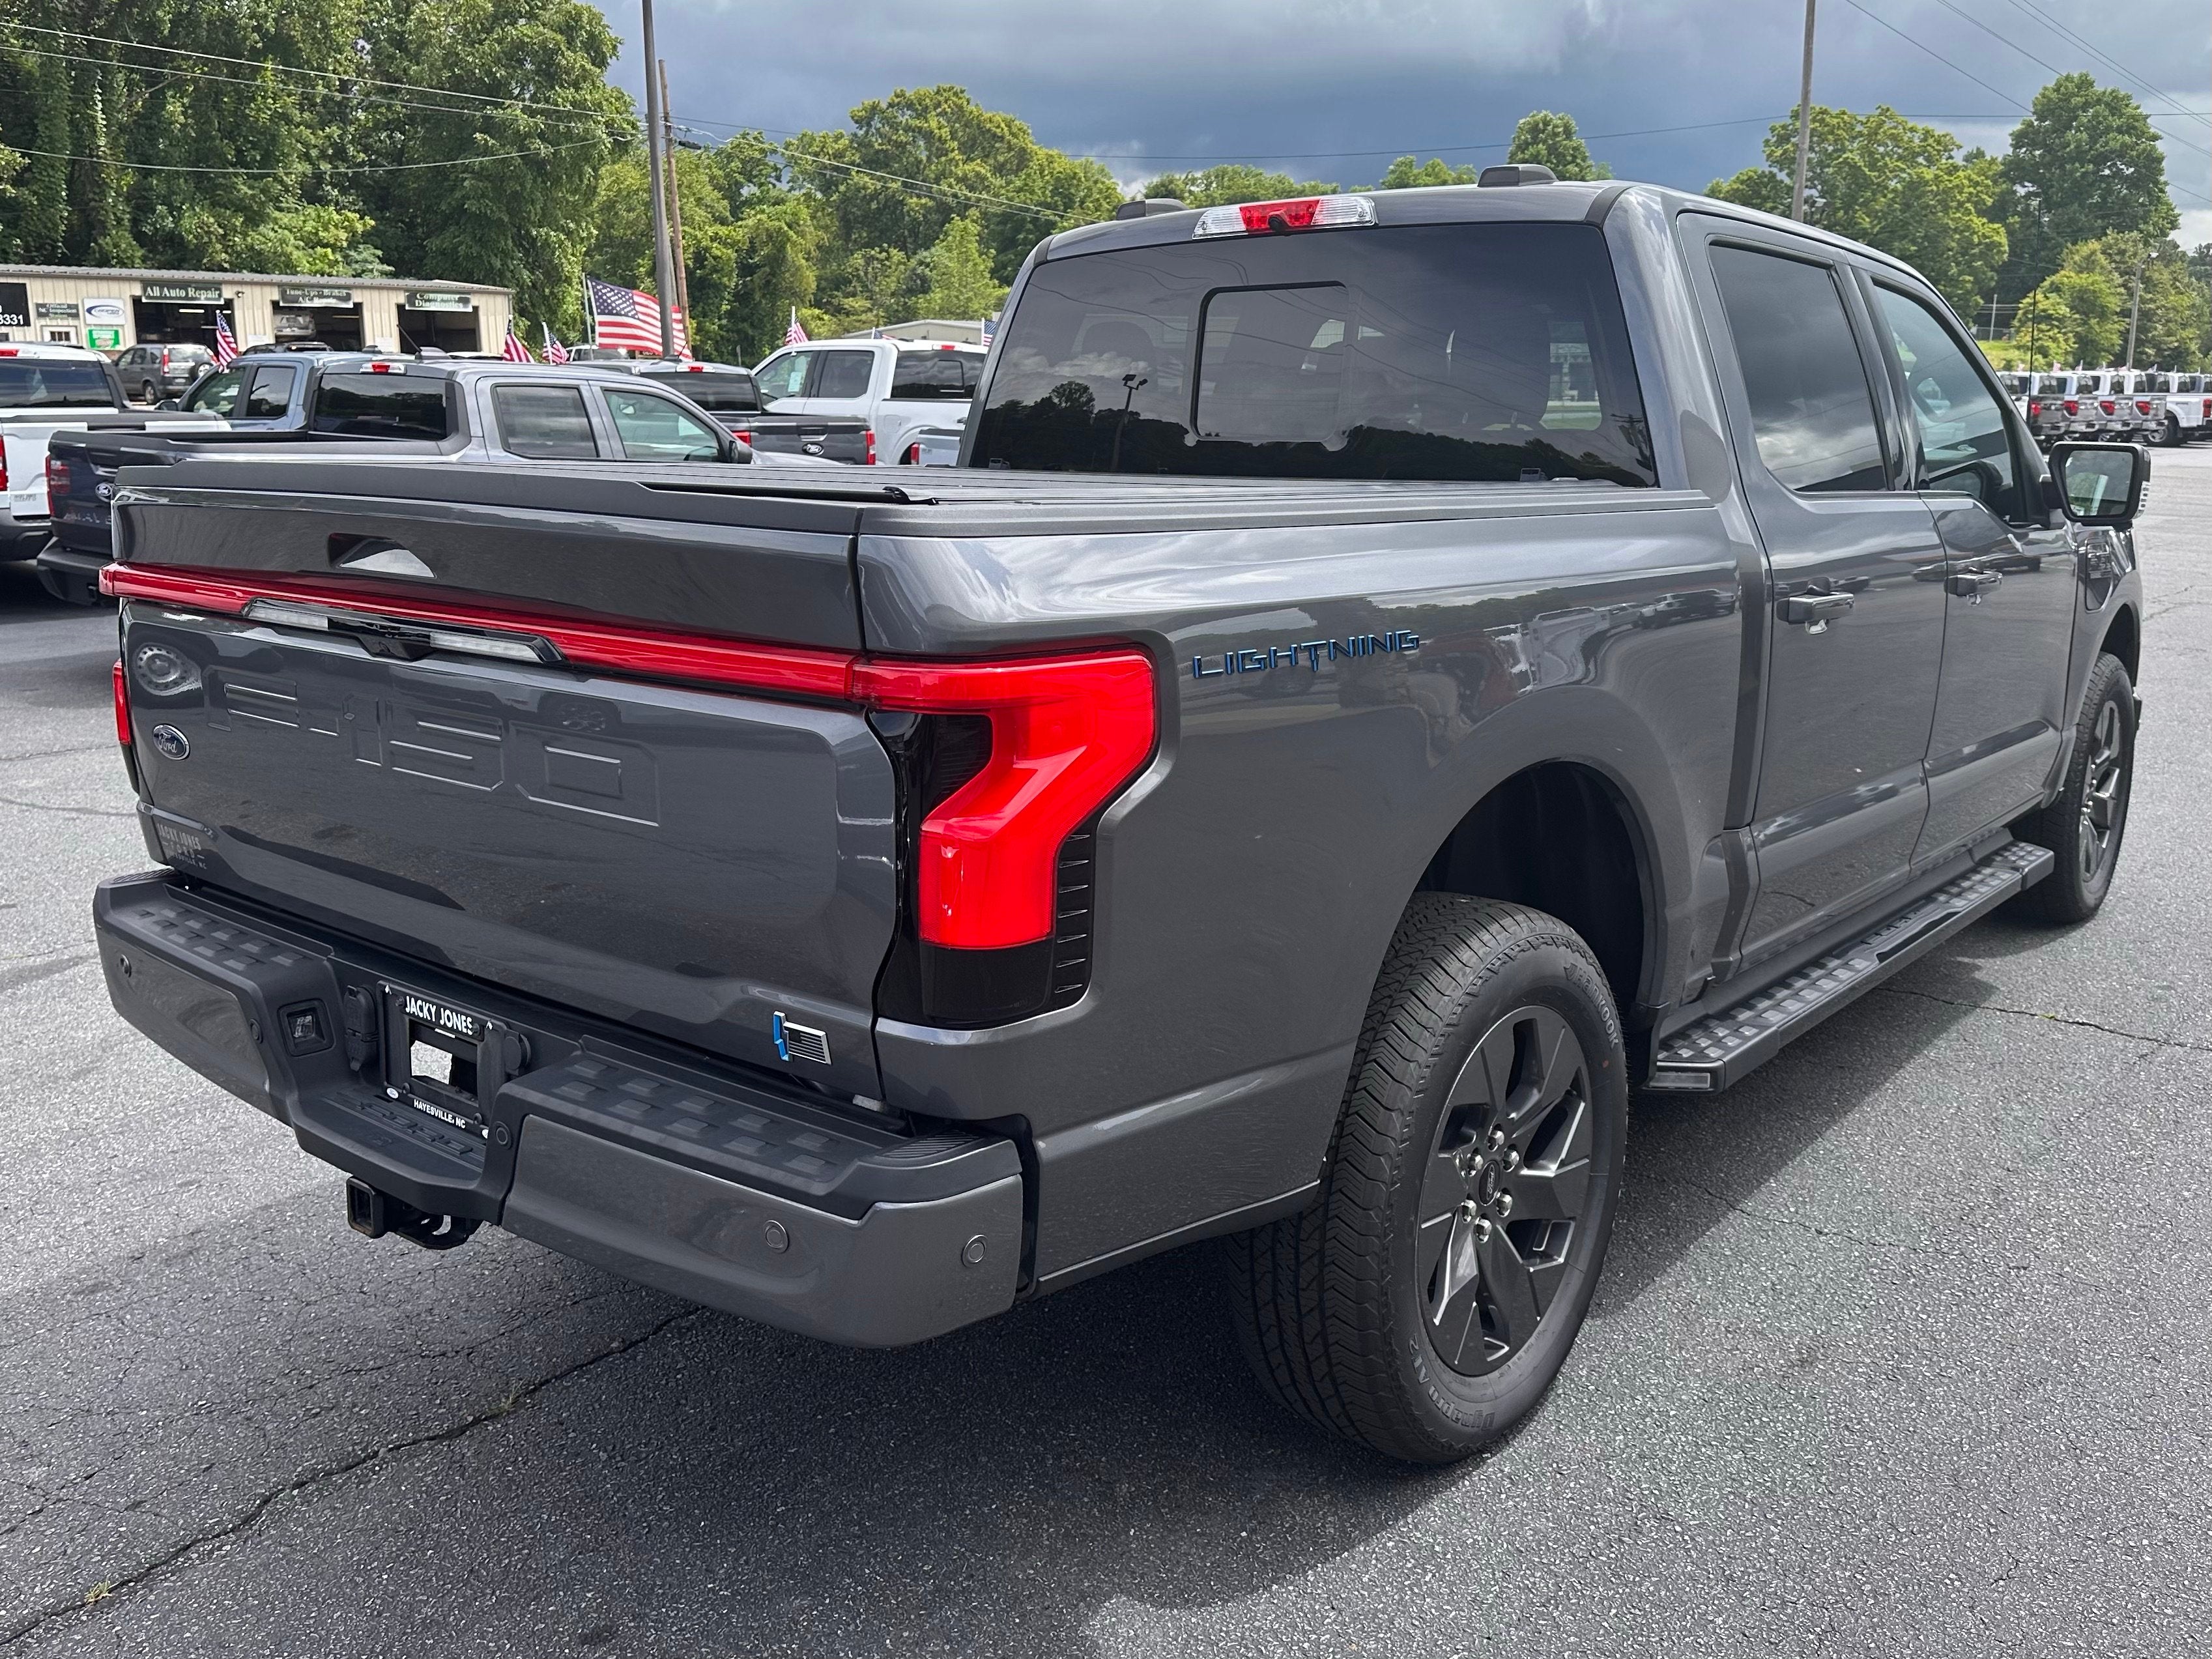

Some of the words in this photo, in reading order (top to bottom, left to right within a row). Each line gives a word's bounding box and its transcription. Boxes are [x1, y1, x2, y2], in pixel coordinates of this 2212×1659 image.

[145, 285, 160, 296] All
[162, 286, 186, 297] Auto
[188, 287, 220, 300] Repair
[415, 299, 463, 309] Diagnostics
[416, 293, 459, 301] Computer
[1193, 629, 1420, 679] LIGHTNING
[158, 730, 177, 753] Ford
[405, 996, 437, 1022] JACKY
[439, 1007, 473, 1035] JONES
[1572, 967, 1619, 1050] Hankook
[414, 1099, 455, 1124] HAYESVILLE,
[455, 1117, 466, 1129] NC
[1428, 1385, 1495, 1431] Dynapro
